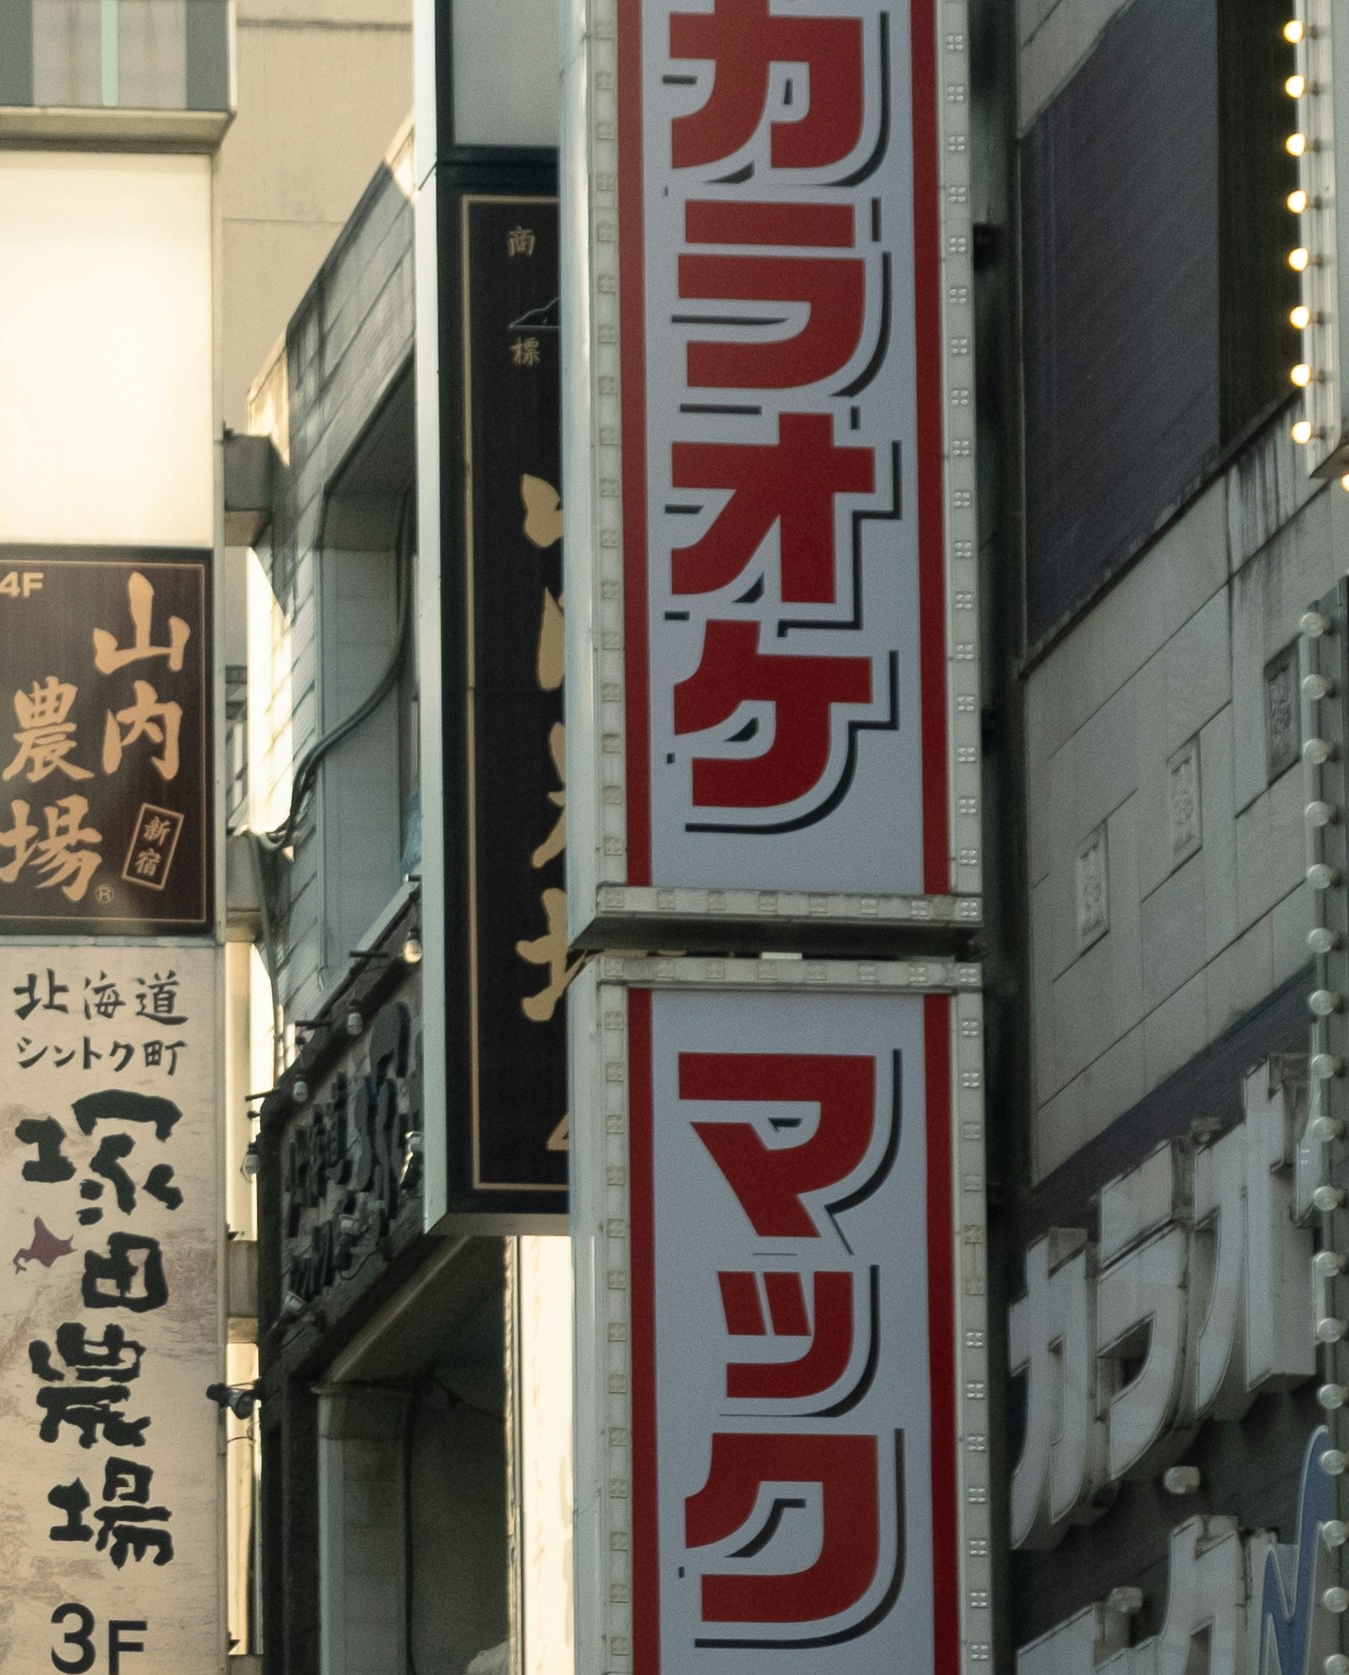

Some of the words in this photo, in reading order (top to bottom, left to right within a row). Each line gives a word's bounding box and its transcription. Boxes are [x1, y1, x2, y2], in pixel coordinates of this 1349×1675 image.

[508, 225, 540, 367] 商標
[664, 0, 893, 826] カラオケ
[93, 571, 192, 781] 山内
[134, 814, 171, 878] 新宿
[13, 968, 188, 1027] 北海道
[15, 1036, 188, 1077] シントク町
[15, 1088, 184, 1570] 塚田農場
[676, 1050, 896, 1640] マック
